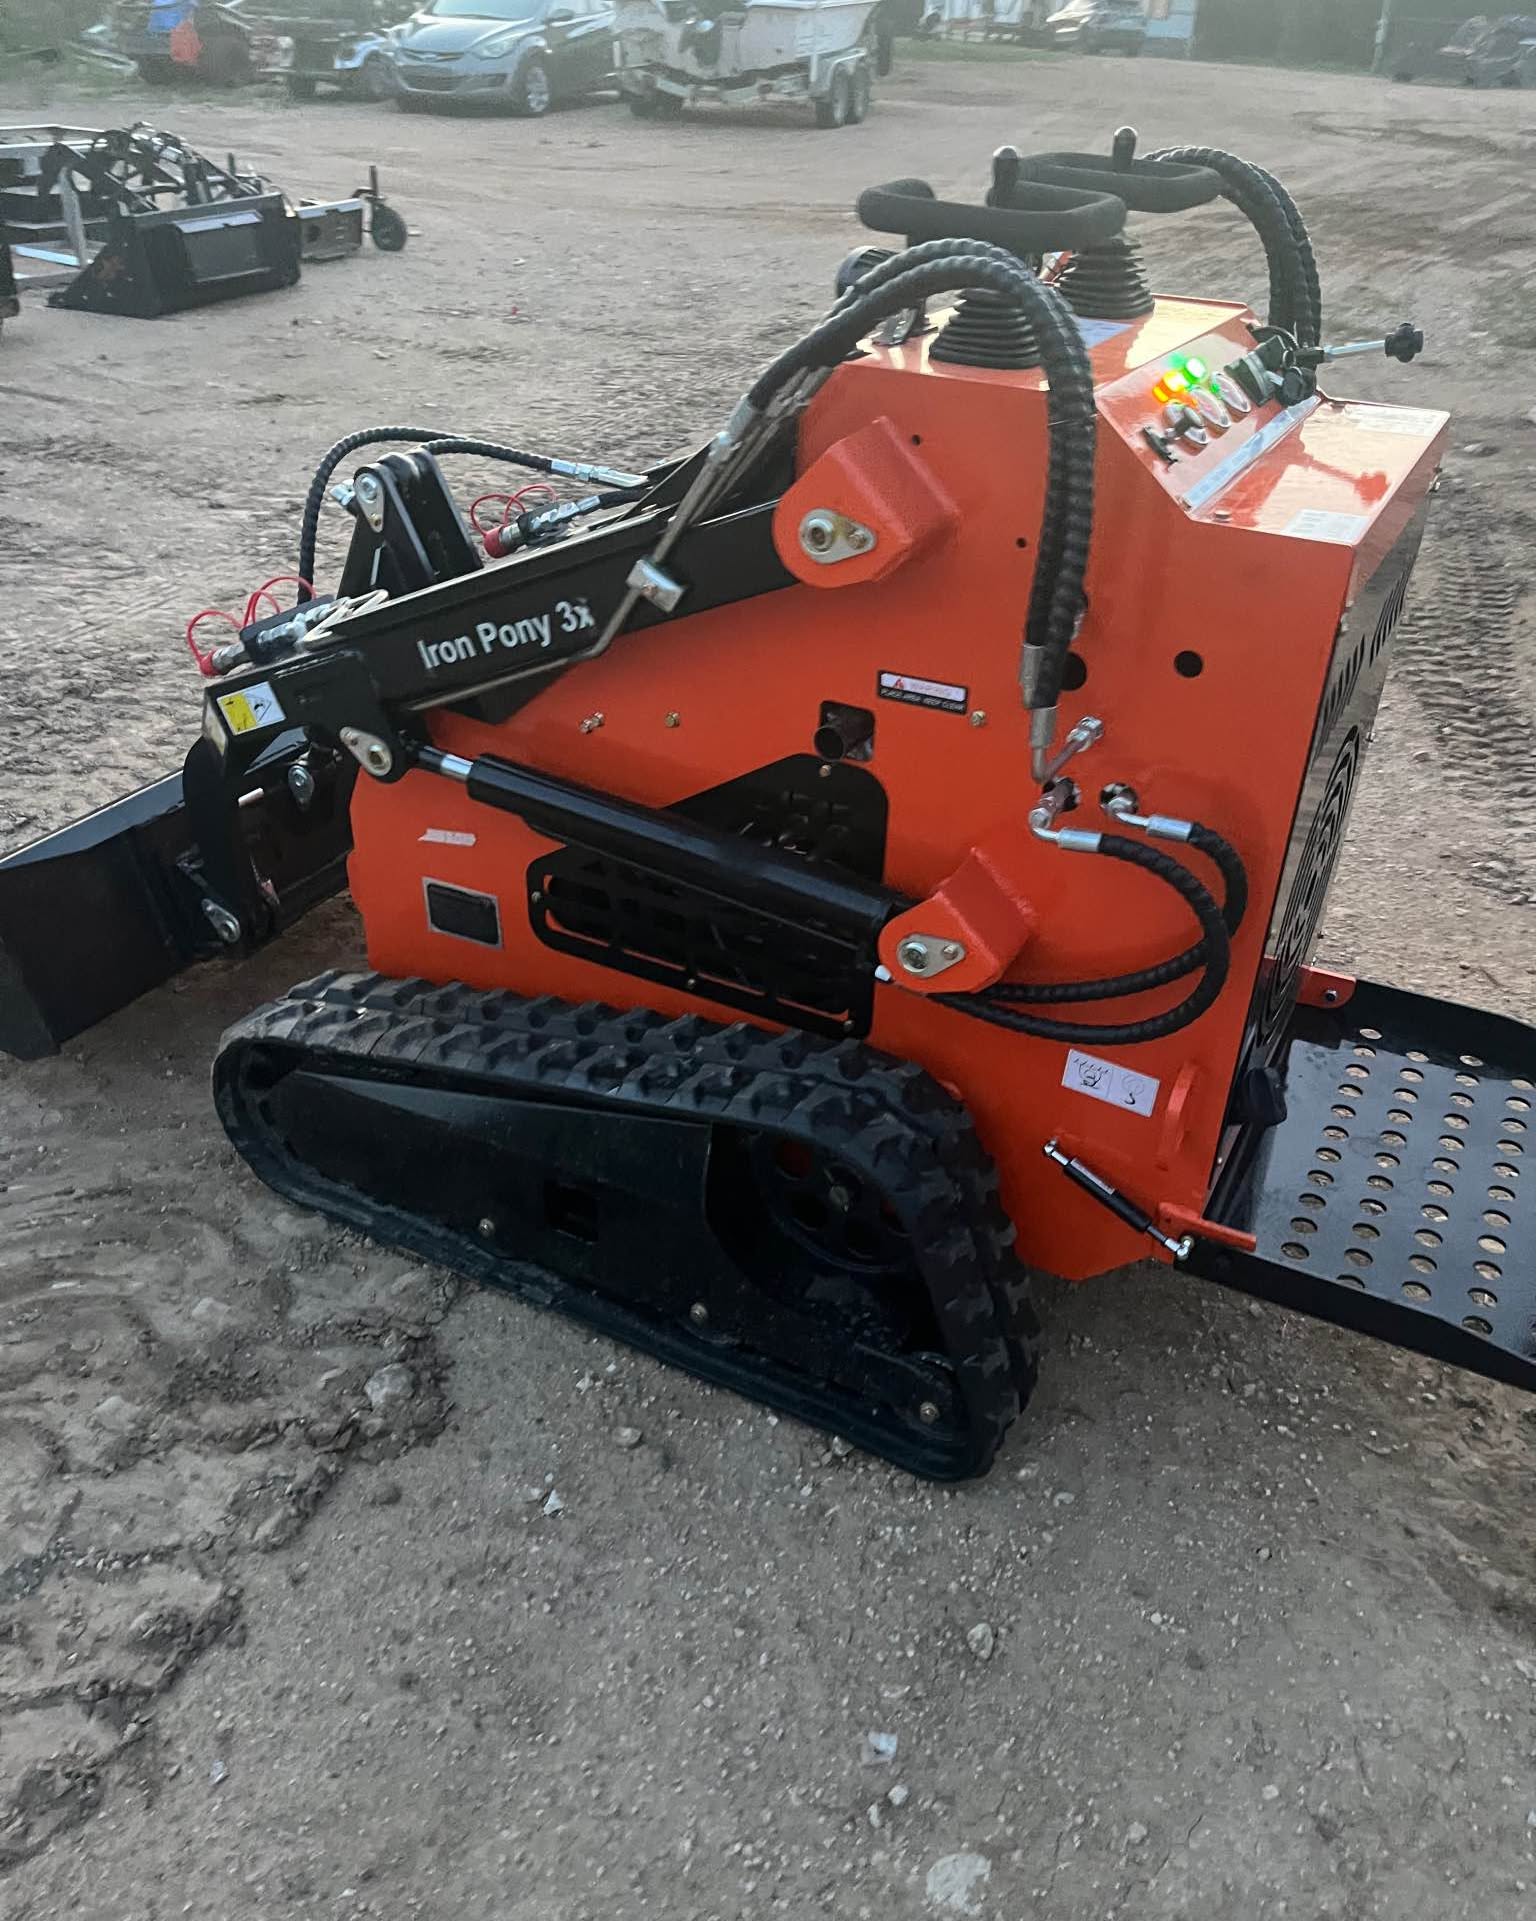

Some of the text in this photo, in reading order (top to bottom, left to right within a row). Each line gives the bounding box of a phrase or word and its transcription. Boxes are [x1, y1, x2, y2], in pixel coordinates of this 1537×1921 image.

[417, 601, 595, 669] Iron Pony 3x
